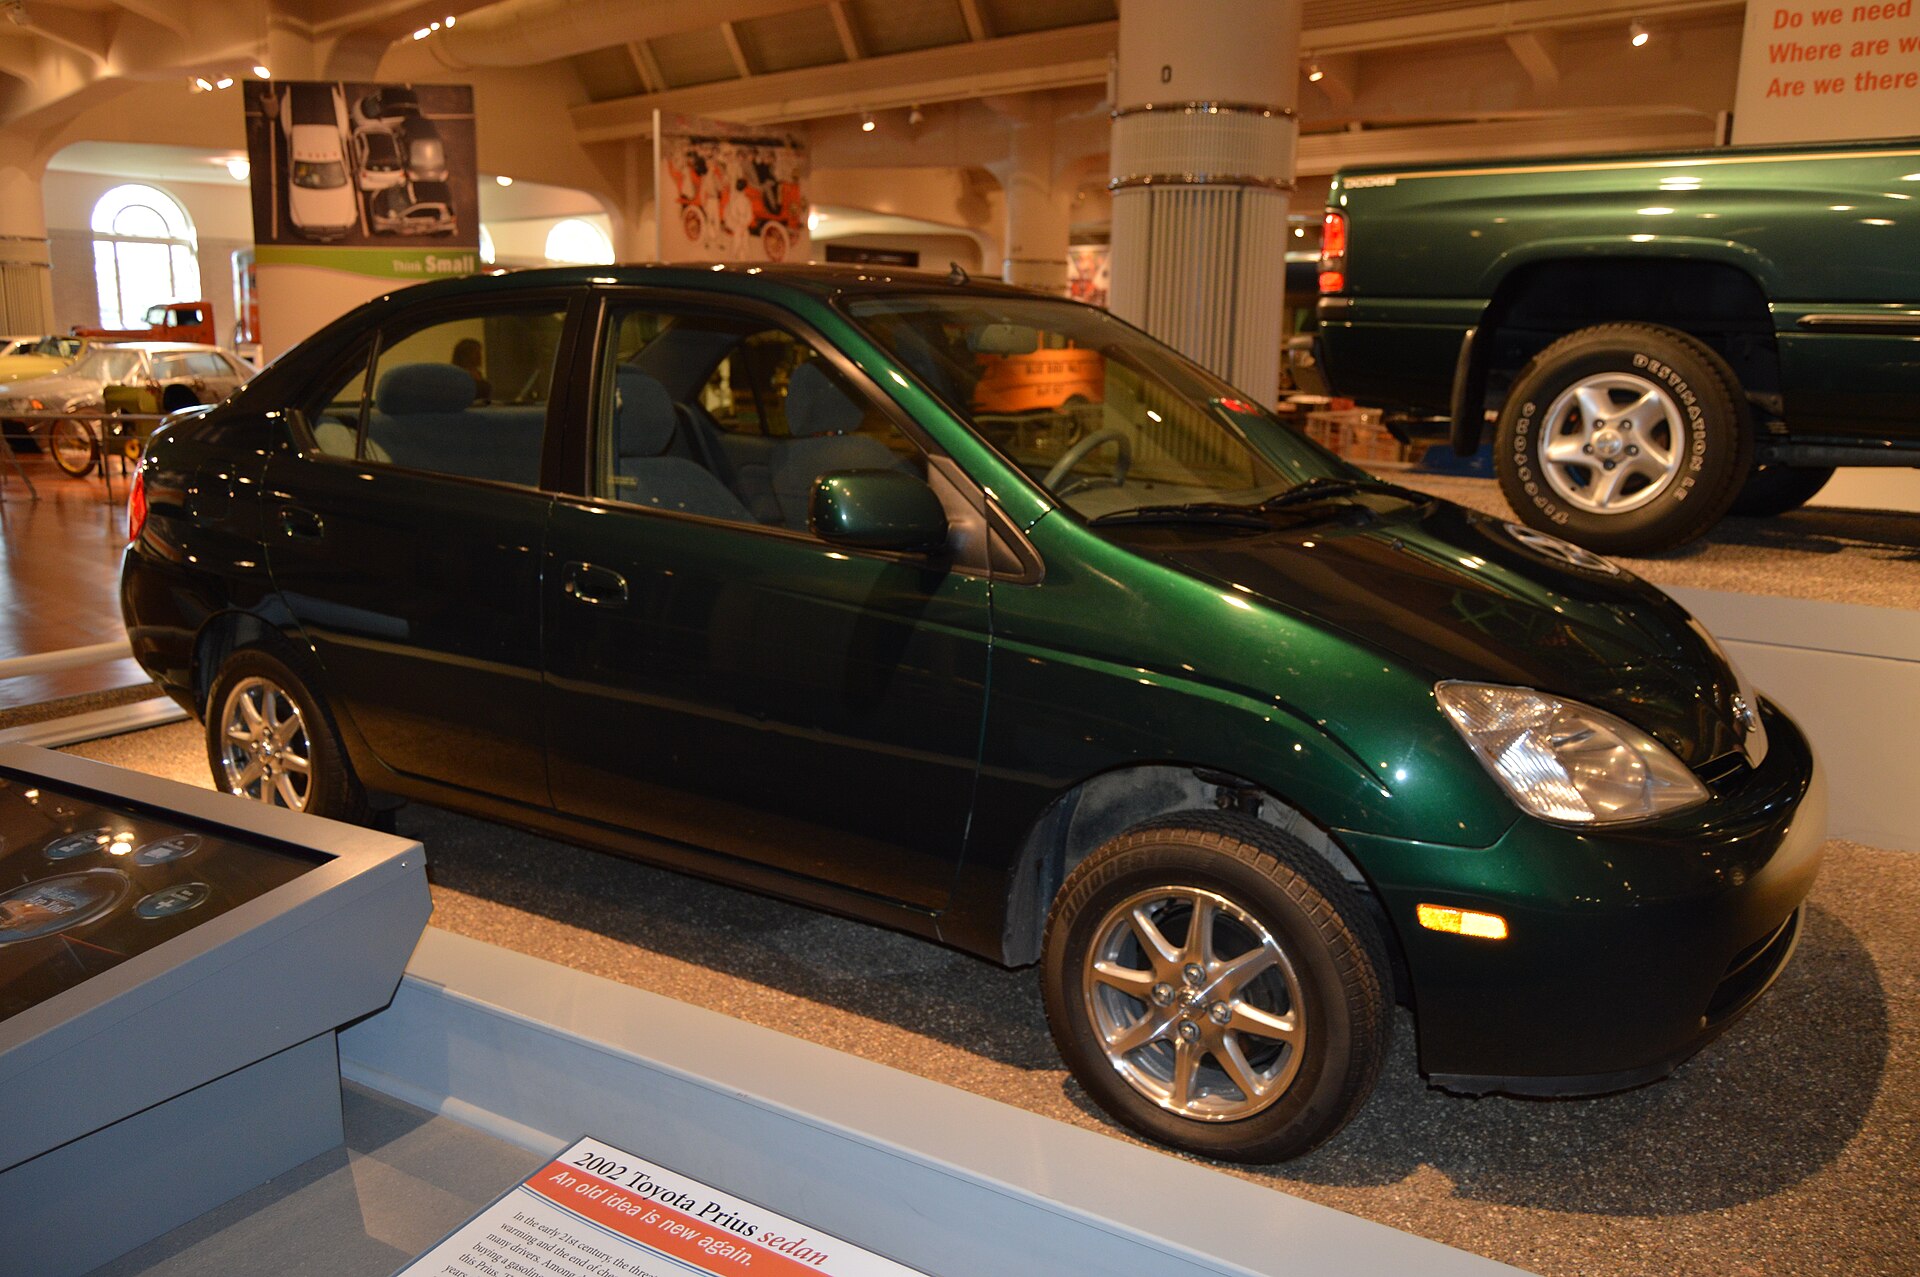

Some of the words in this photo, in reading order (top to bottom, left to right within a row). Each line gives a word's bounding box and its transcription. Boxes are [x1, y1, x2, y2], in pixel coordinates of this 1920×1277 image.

[1773, 9, 1802, 30] Do
[1812, 8, 1843, 26] we
[1852, 0, 1912, 22] need
[1768, 43, 1841, 64] Where
[1850, 38, 1889, 58] are
[1766, 77, 1805, 98] Are
[1813, 77, 1845, 95] we
[1854, 71, 1918, 92] there
[425, 255, 475, 273] Small
[1633, 353, 1706, 472] DESTINATION
[549, 1171, 576, 1188] An
[575, 1183, 609, 1199] old
[601, 1193, 642, 1216] idea
[640, 1209, 661, 1224] is
[657, 1219, 701, 1240] new
[698, 1236, 753, 1266] again.
[573, 1152, 628, 1181] 2002
[625, 1171, 696, 1211] Toyota
[696, 1201, 758, 1236] Prius
[757, 1231, 828, 1265] sedan
[472, 1242, 503, 1263] buying
[486, 1233, 511, 1249] many
[510, 1244, 540, 1263] drivers.
[500, 1223, 538, 1246] warming
[536, 1241, 557, 1252] and
[554, 1248, 569, 1258] the
[568, 1256, 590, 1267] end
[586, 1264, 602, 1272] of
[513, 1212, 525, 1221] In
[524, 1217, 539, 1227] the
[538, 1227, 561, 1238] early
[558, 1232, 580, 1246] 21st
[577, 1243, 612, 1263] century,
[612, 1258, 629, 1269] the
[459, 1254, 476, 1265] this
